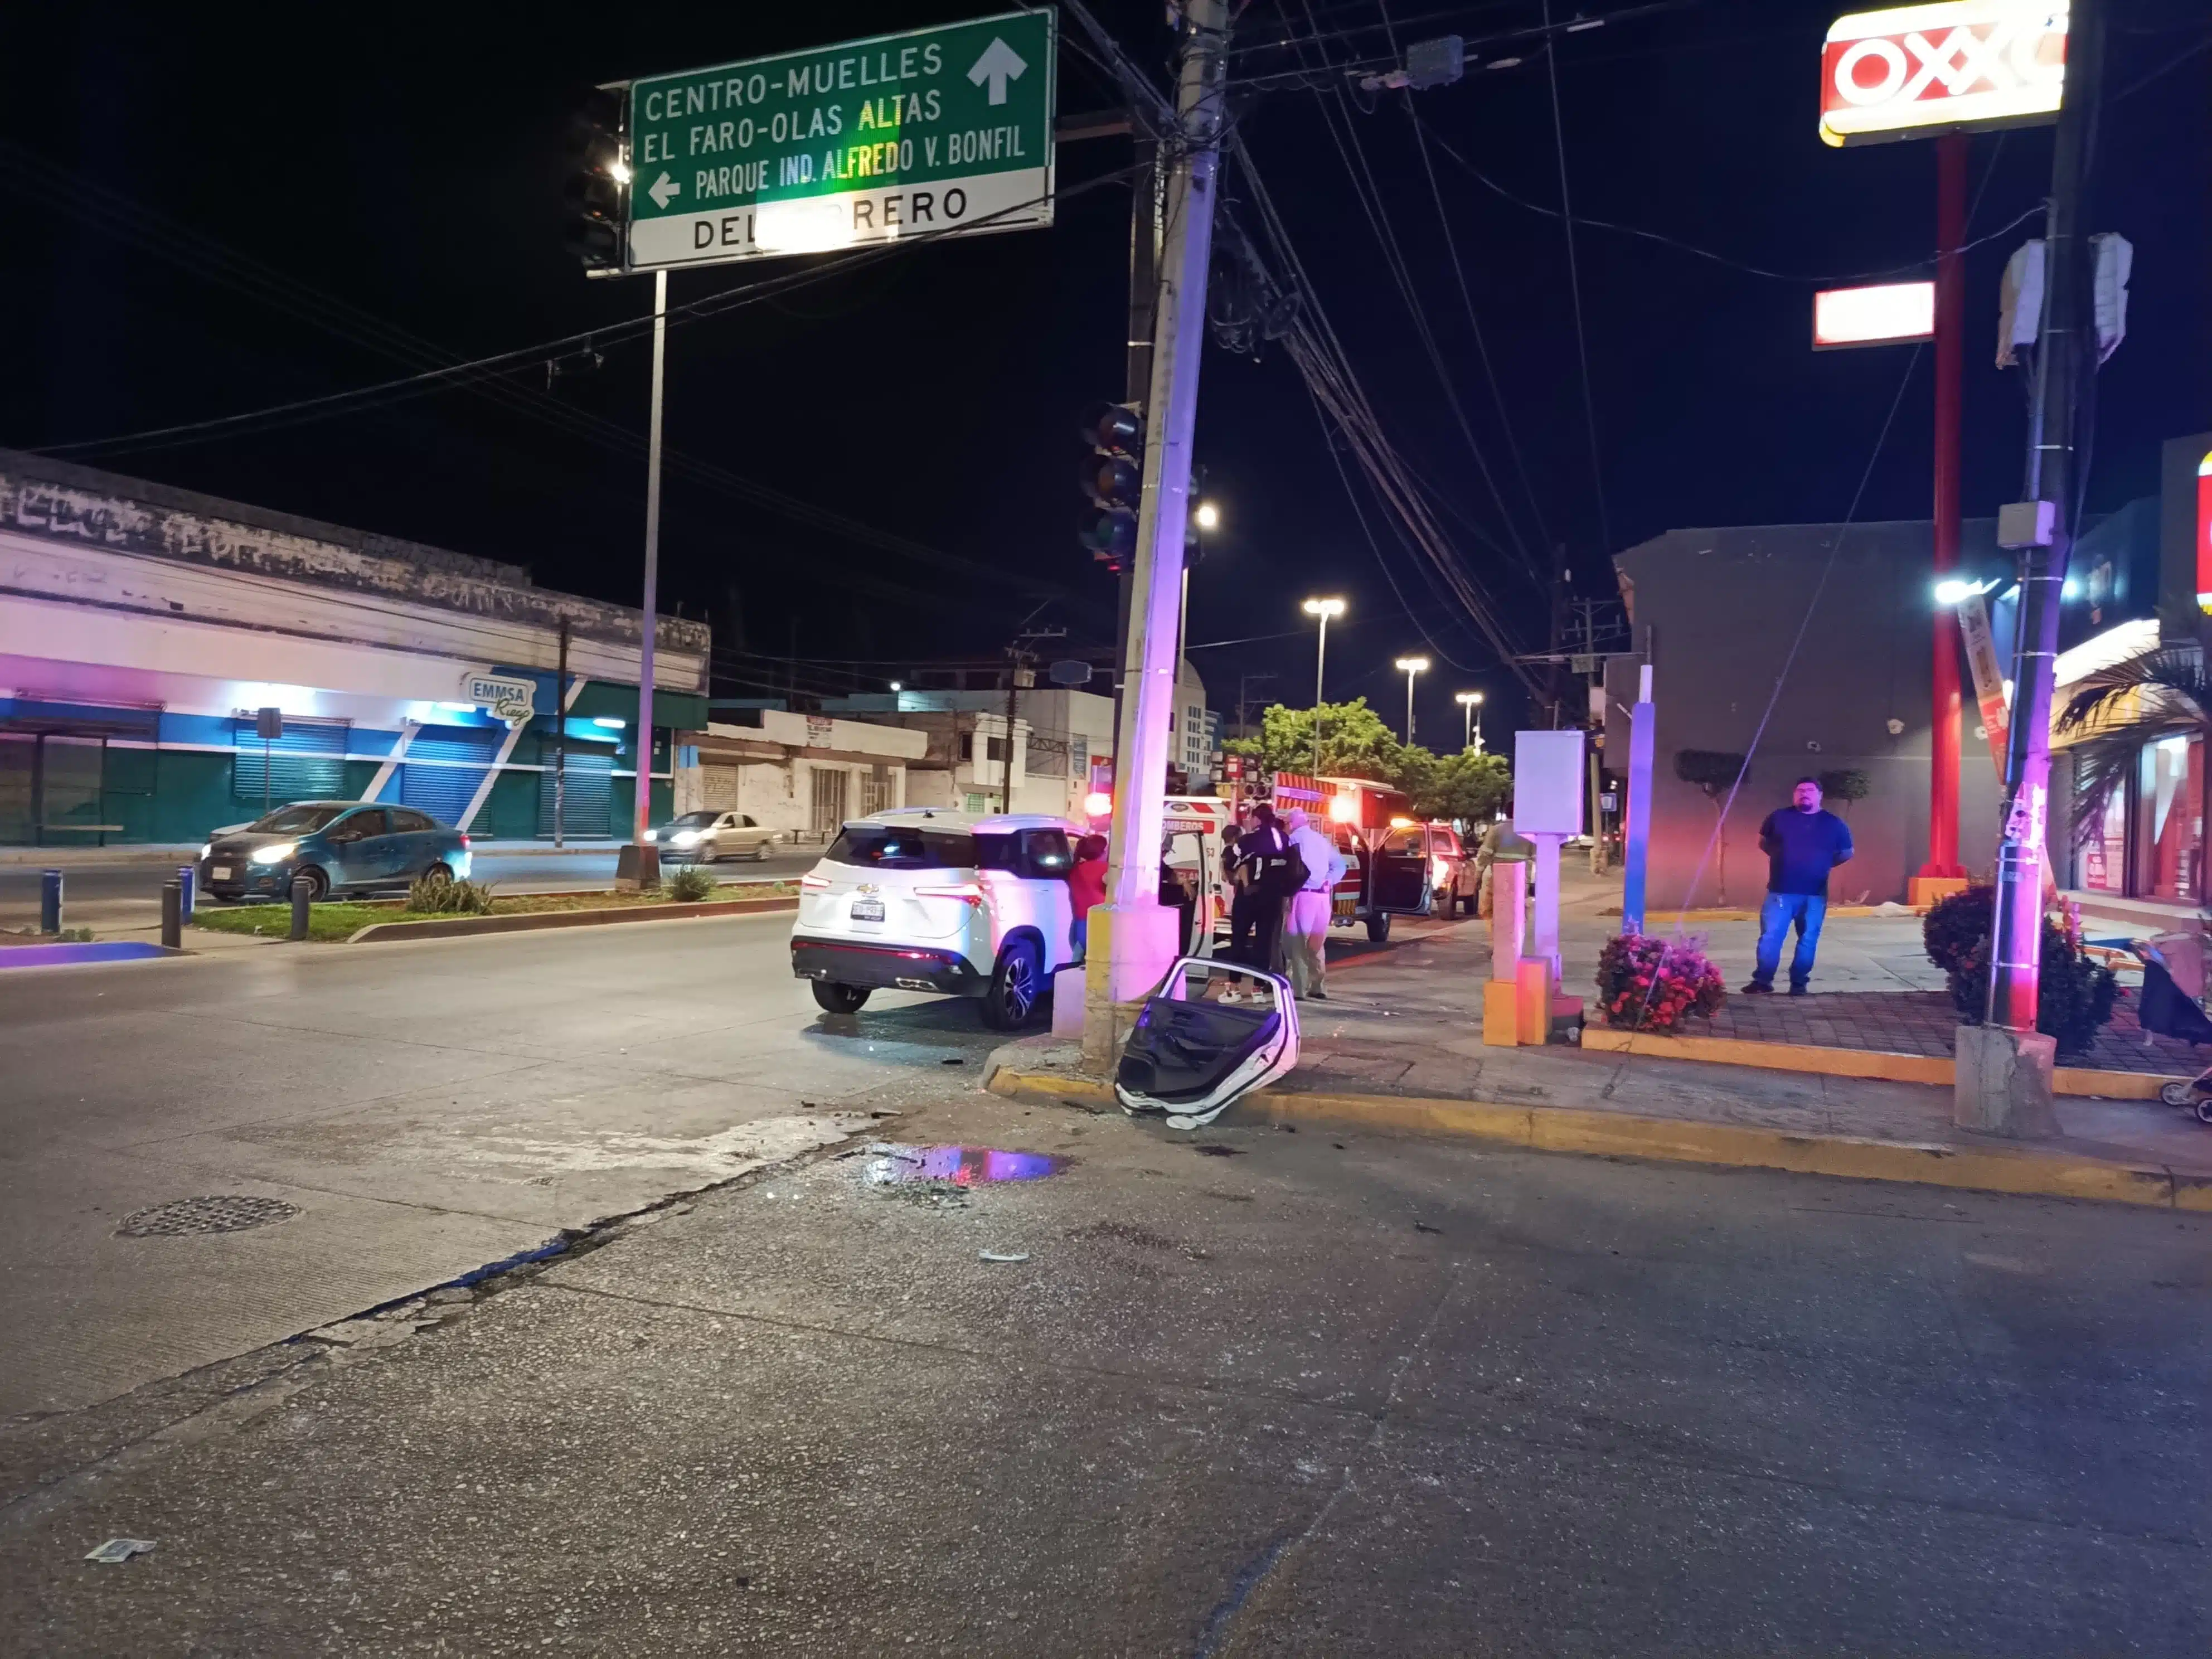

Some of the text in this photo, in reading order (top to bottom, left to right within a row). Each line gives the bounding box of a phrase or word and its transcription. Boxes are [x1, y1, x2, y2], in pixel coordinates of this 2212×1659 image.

[645, 43, 943, 122] CENTRO-MUELLES
[644, 90, 942, 163] EL FARO-OLAS ALTAS
[695, 125, 1026, 200] PARQUE IND. ALFREDO V. BONFIL
[474, 682, 524, 702] EMMSA
[494, 697, 530, 726] Riego
[1162, 820, 1204, 831] OMBEROS
